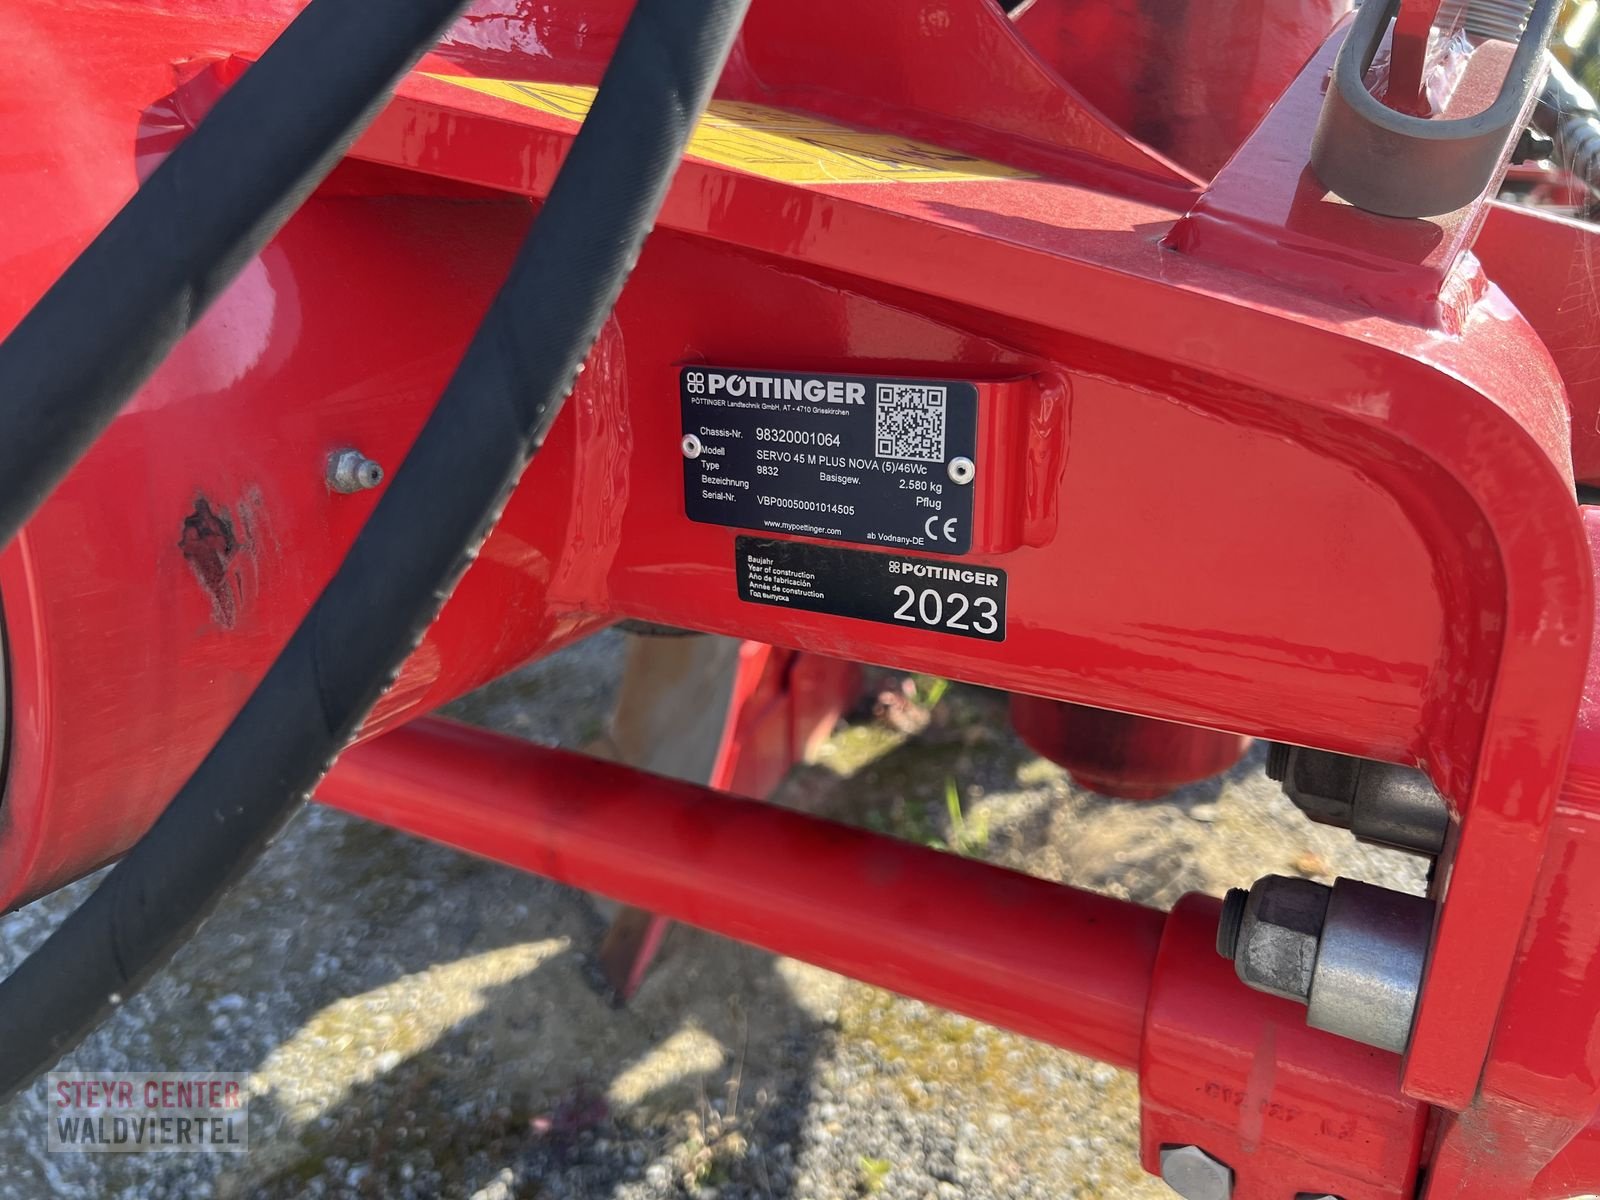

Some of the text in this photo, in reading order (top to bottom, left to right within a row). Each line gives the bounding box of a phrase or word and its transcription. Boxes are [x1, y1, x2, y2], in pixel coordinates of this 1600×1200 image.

[727, 400, 760, 410] Landtechnik
[761, 403, 781, 412] GmbH,
[782, 404, 791, 412] AT
[796, 405, 811, 413] 4710
[700, 426, 841, 448] Chassis-Nr. 98320001064
[701, 445, 928, 475] Modell SERVO 45 M PLUS NOVA (5)/46Wc
[701, 460, 779, 477] Type 9832
[701, 475, 750, 490] Bezeichnung
[819, 472, 943, 494] Basisgew. 2.580 kg
[702, 490, 855, 516] Serial-Nr. VBP00050001014505
[916, 496, 942, 510] Pflug
[764, 519, 842, 536] www.mypoettinger.com
[866, 532, 925, 546] ab Vodnany-DE
[747, 555, 774, 565] Baujahr
[748, 564, 763, 572] Year
[772, 568, 815, 580] construction
[748, 572, 762, 581] Año
[773, 576, 812, 588] fabricación
[749, 581, 825, 599] Année de construction
[749, 589, 762, 598] Год
[893, 585, 999, 635] 2023
